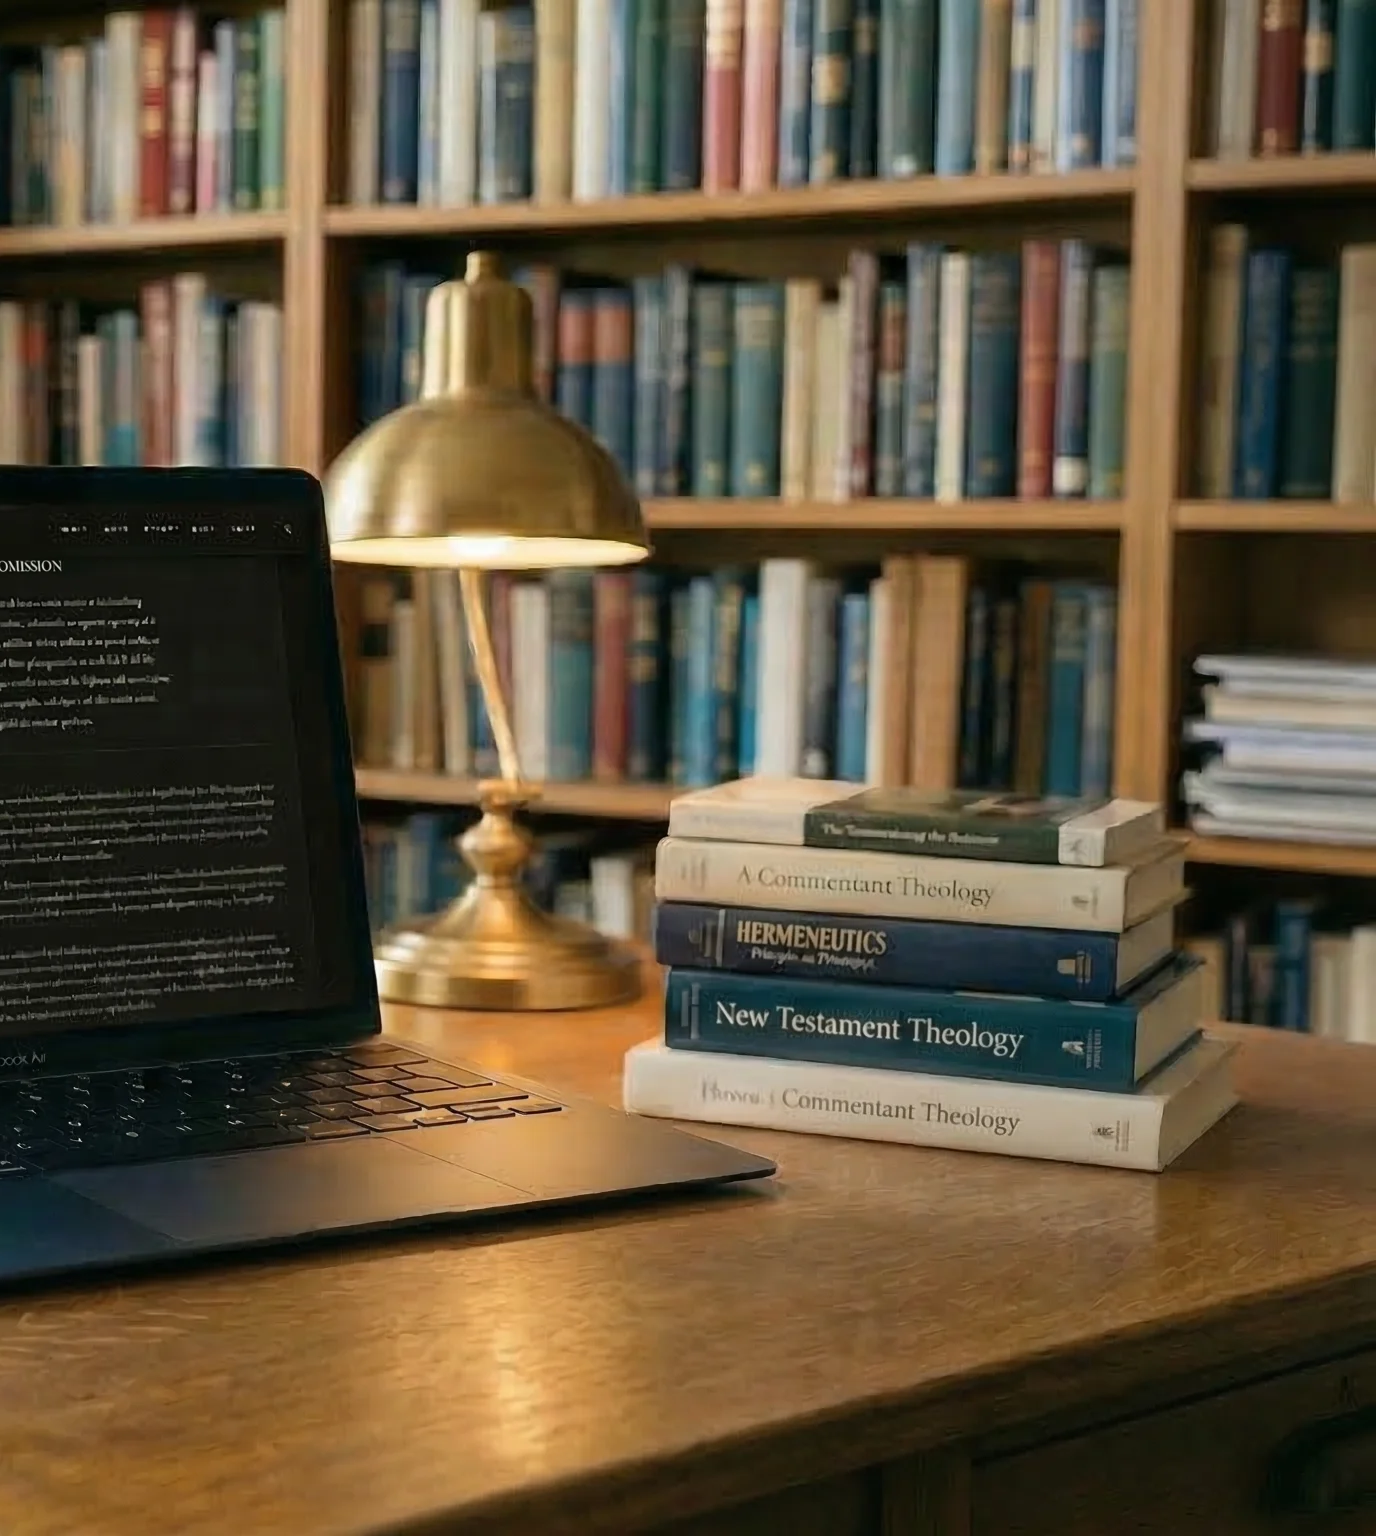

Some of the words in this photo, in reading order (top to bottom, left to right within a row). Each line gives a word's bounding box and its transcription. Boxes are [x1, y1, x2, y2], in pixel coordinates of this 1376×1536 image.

[737, 864, 752, 885] A
[896, 876, 995, 907] Theology
[736, 919, 887, 955] HERMENEUTICS
[716, 1001, 770, 1027] New
[776, 1005, 901, 1041] Testament
[908, 1018, 1024, 1057] Theology
[781, 1087, 915, 1121] Commentant
[921, 1102, 1020, 1137] Theology
